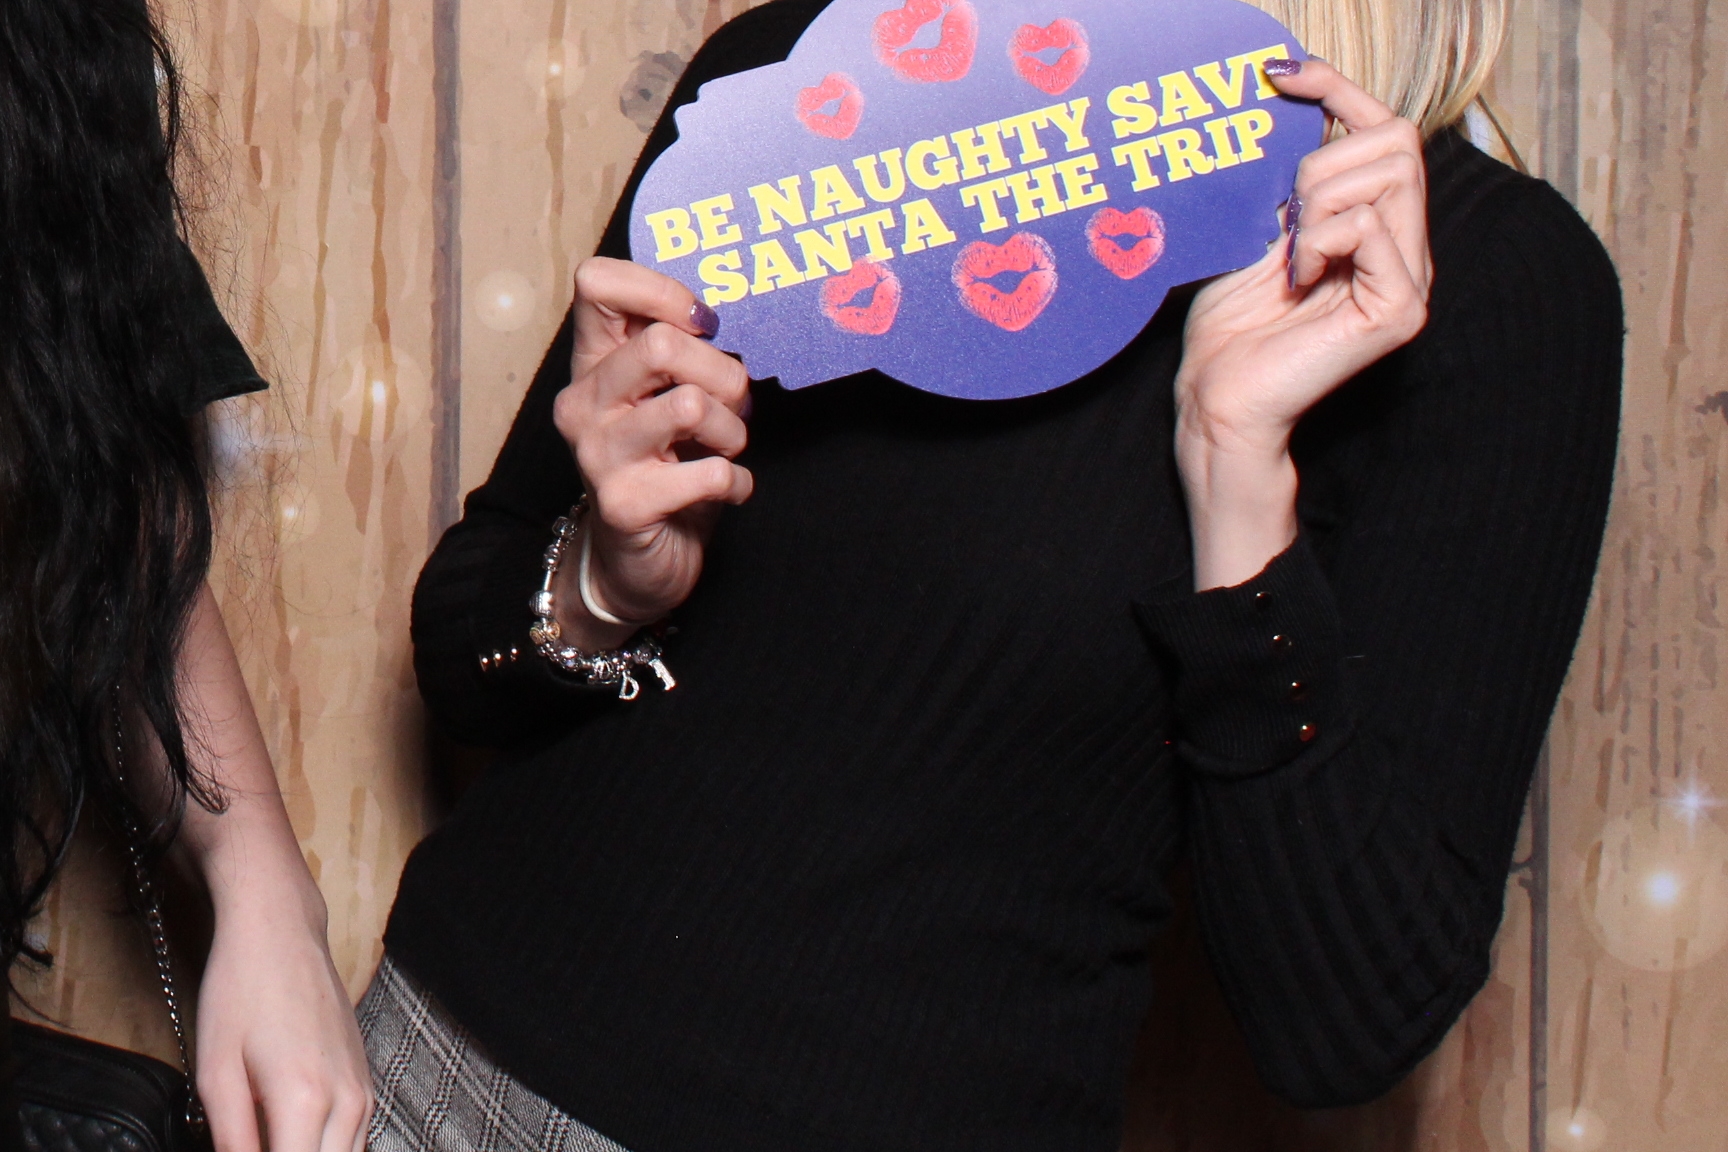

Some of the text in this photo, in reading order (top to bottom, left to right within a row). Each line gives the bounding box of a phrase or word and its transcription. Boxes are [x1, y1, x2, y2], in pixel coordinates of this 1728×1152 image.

[645, 194, 744, 262] BE
[748, 96, 1090, 239] NAUGHTY
[696, 108, 1274, 306] SANTA THE TRIP
